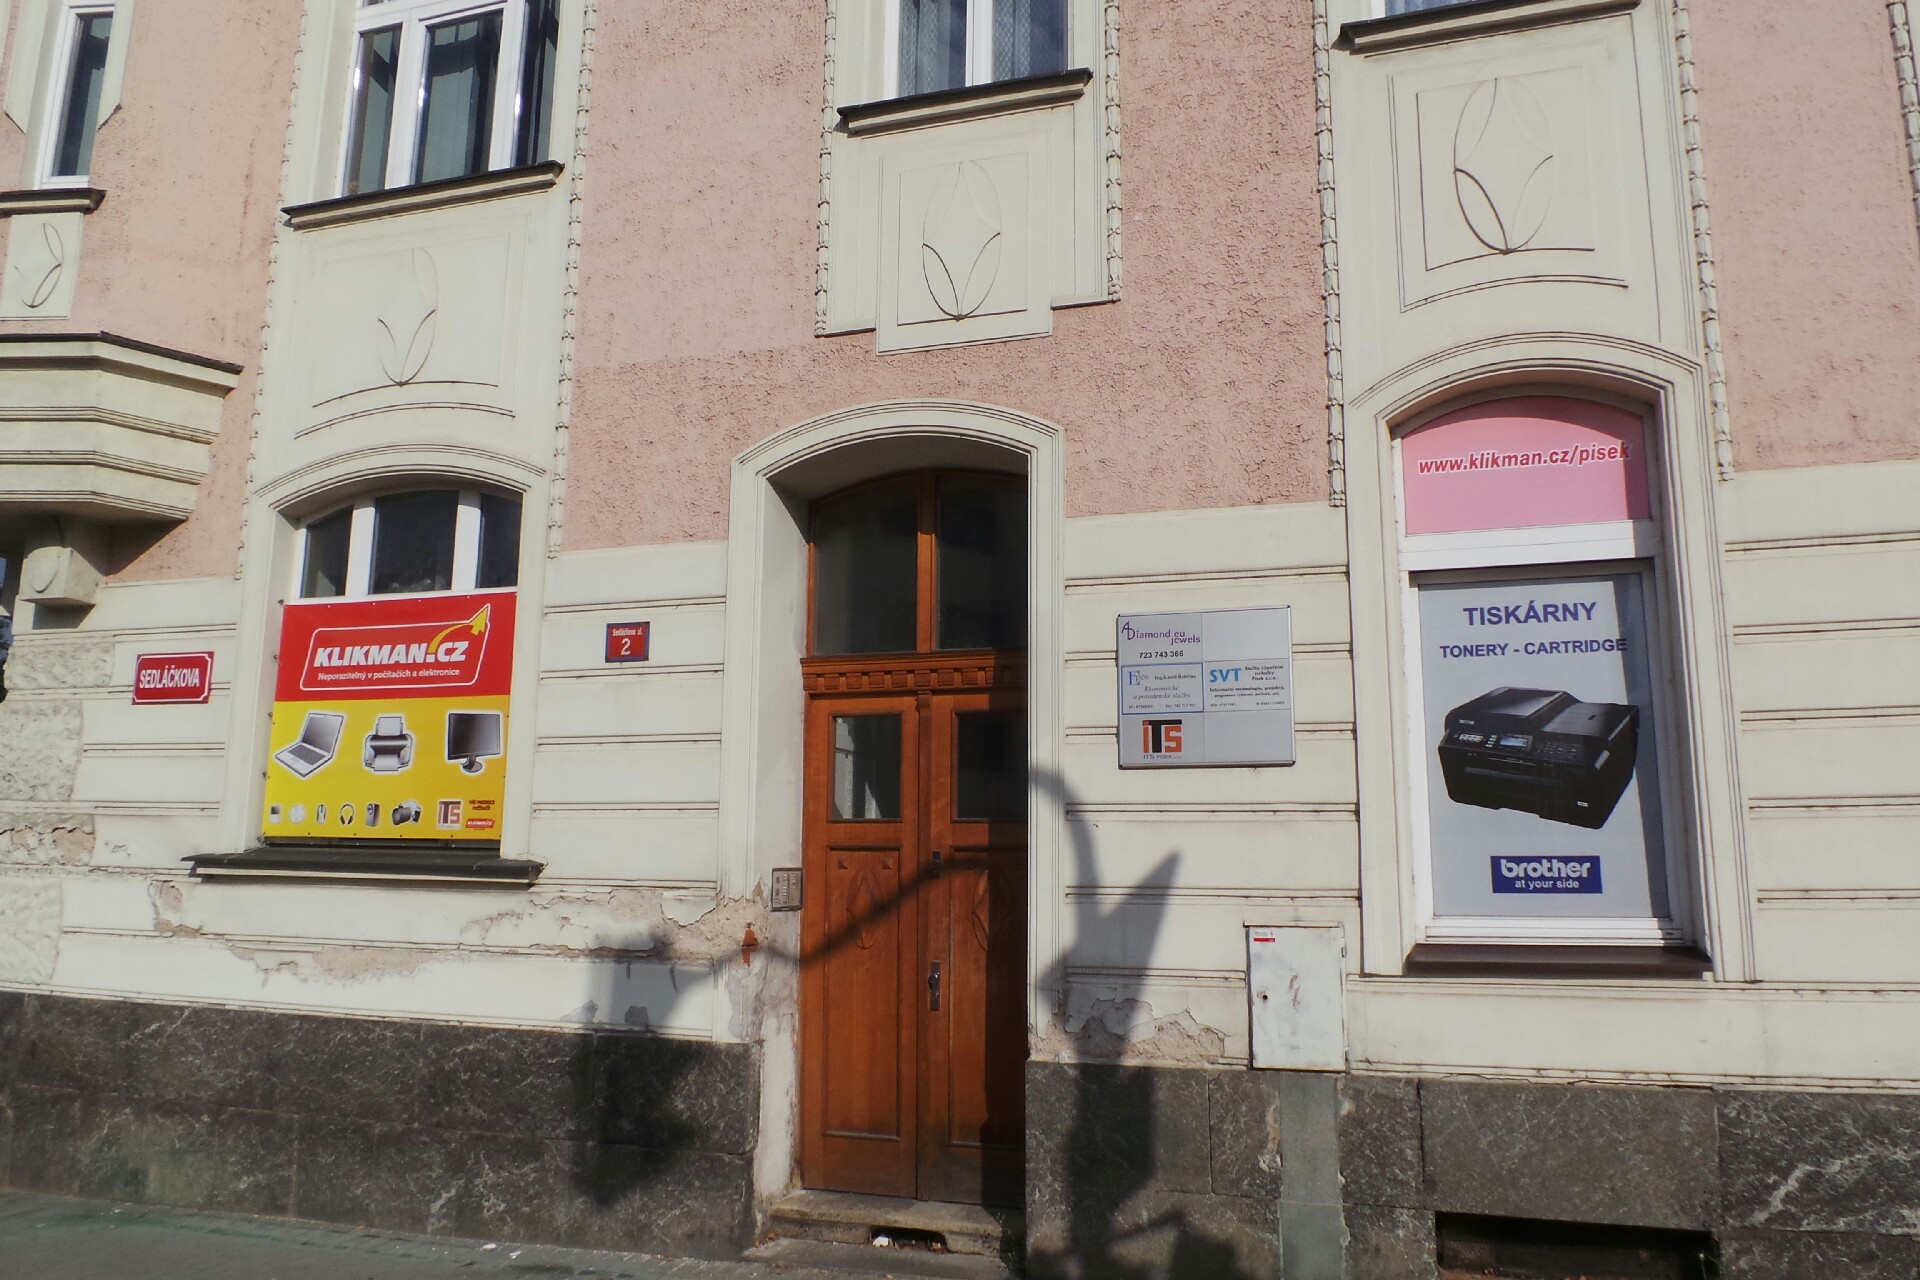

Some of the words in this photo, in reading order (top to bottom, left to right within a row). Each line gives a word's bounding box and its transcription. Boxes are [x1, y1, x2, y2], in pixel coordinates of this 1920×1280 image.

[1419, 441, 1631, 474] www.klikman.cz/pisek
[1463, 600, 1598, 626] TISKÁRNY
[620, 637, 631, 656] 2
[1170, 634, 1201, 646] jewels
[1439, 643, 1509, 658] TONERY
[1524, 638, 1629, 655] CARTRIDGE
[313, 641, 470, 667] KLIKMAN.CZ
[139, 664, 200, 689] SEDLÁČKOVA
[318, 671, 366, 681] Neporazitelný
[418, 668, 460, 677] elektronice
[1209, 668, 1242, 683] SVT
[1500, 858, 1591, 878] brother
[1514, 880, 1526, 888] at
[1528, 880, 1554, 890] your
[1556, 879, 1580, 888] side
